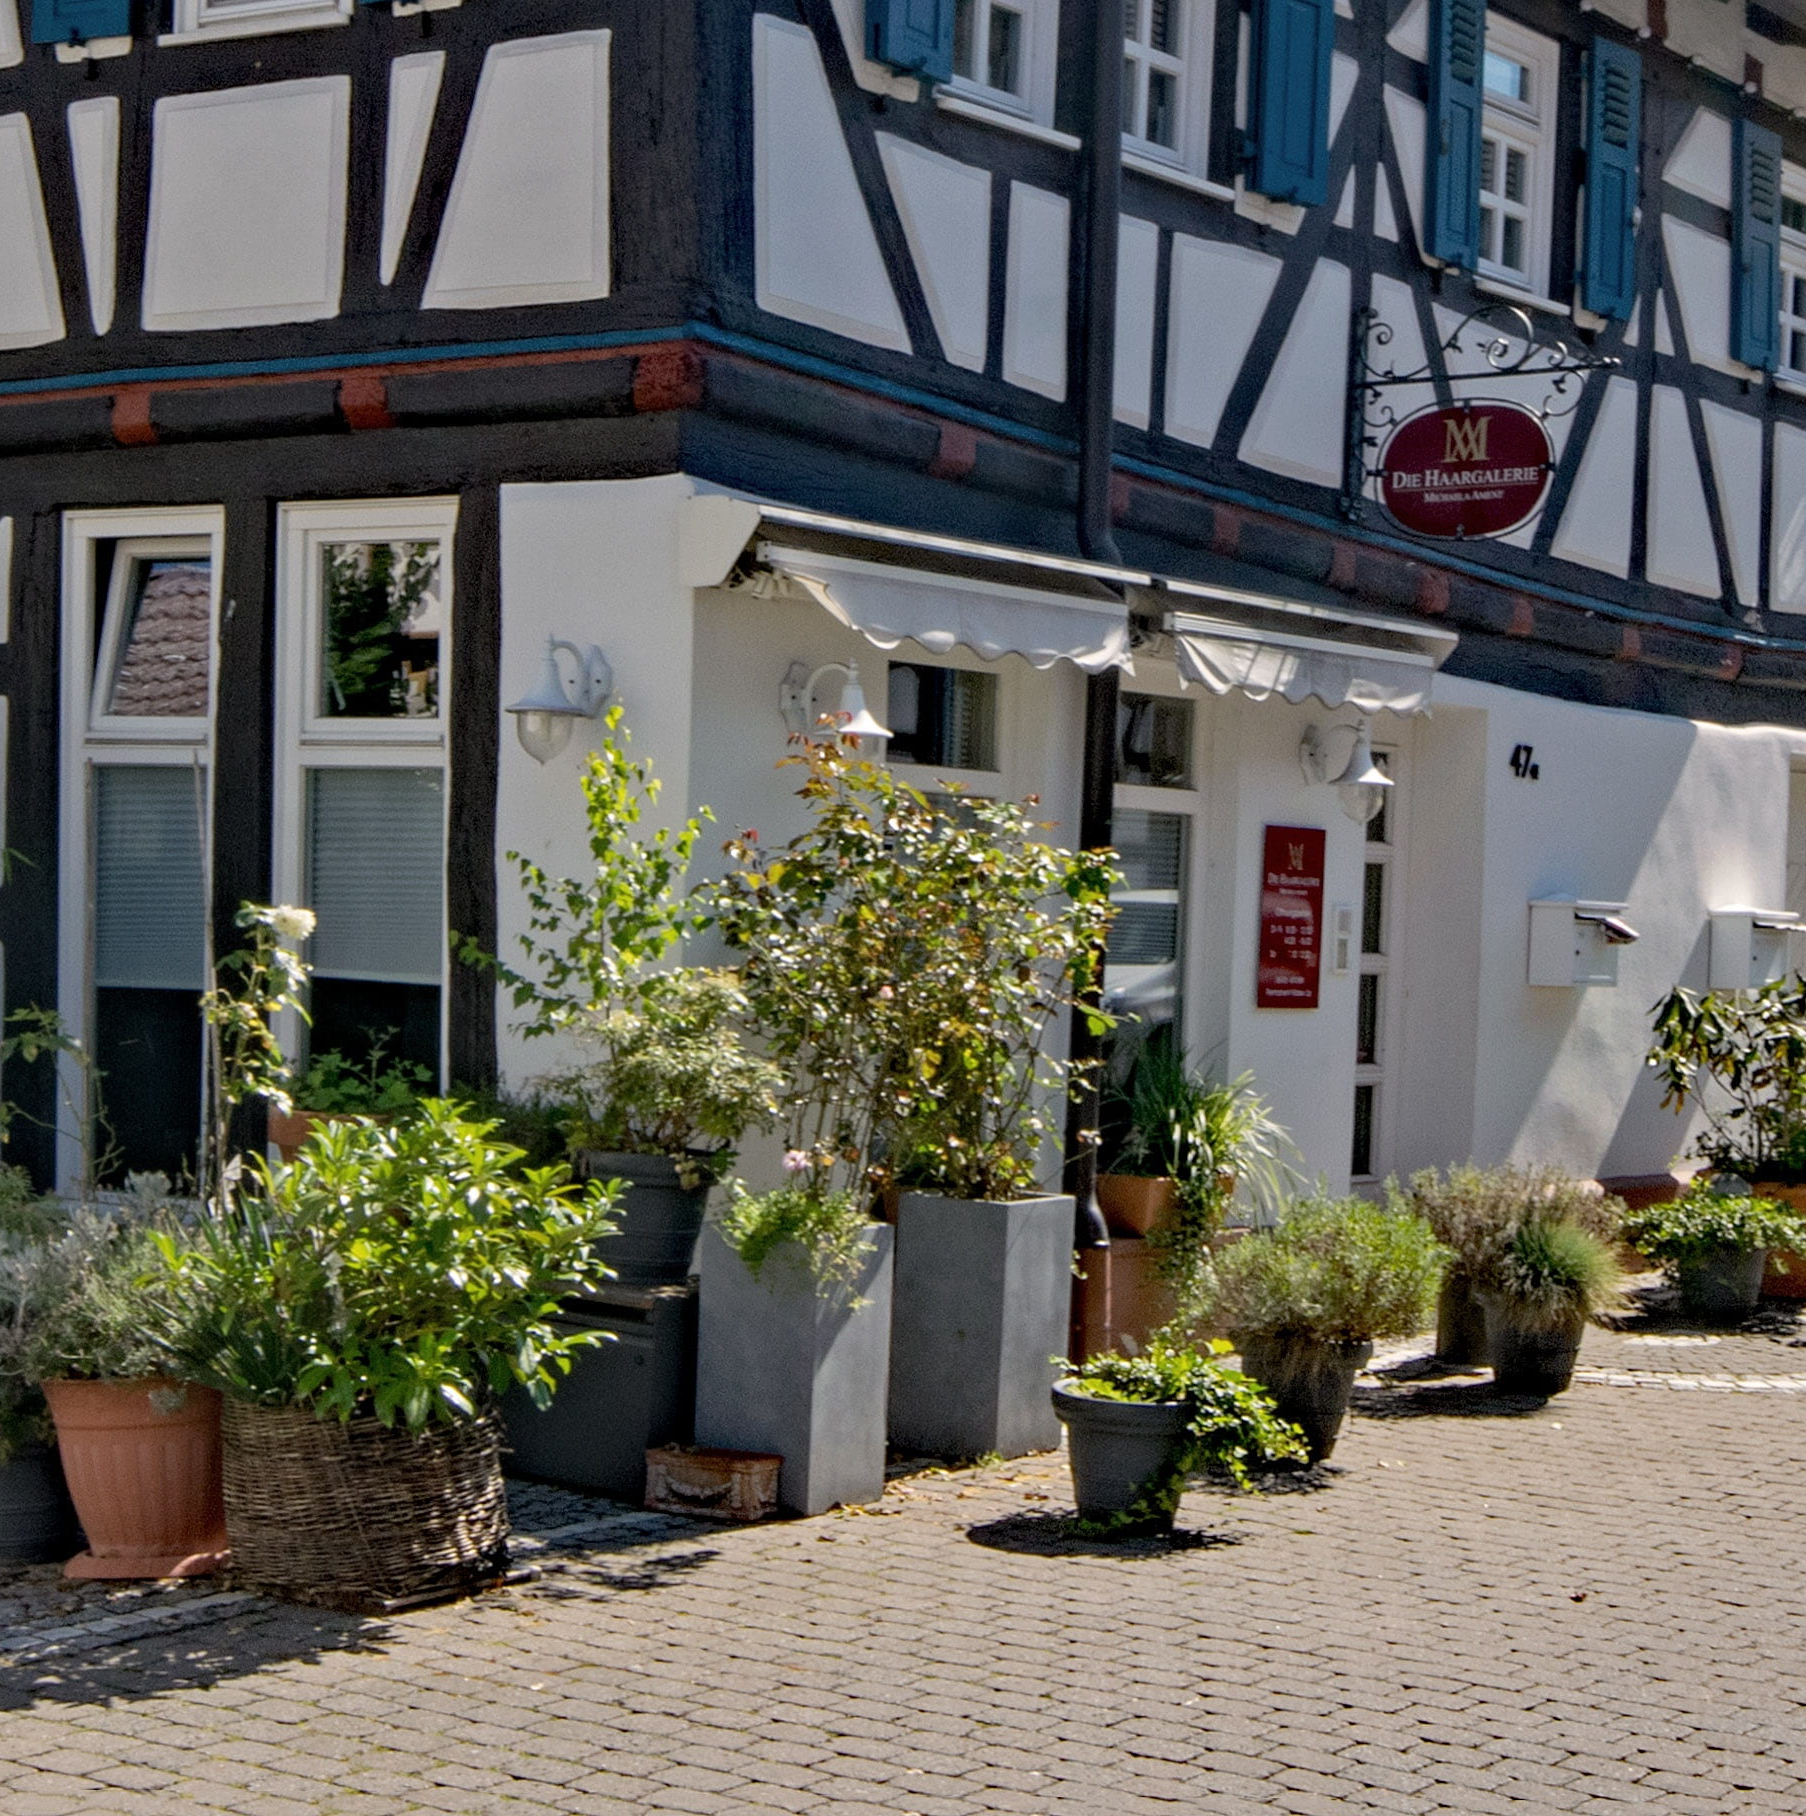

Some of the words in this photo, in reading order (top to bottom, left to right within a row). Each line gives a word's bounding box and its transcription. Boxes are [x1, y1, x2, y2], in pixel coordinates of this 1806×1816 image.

[1392, 470, 1422, 489] DIE
[1424, 466, 1540, 487] HAARGALERIE
[1509, 744, 1540, 780] 47a
